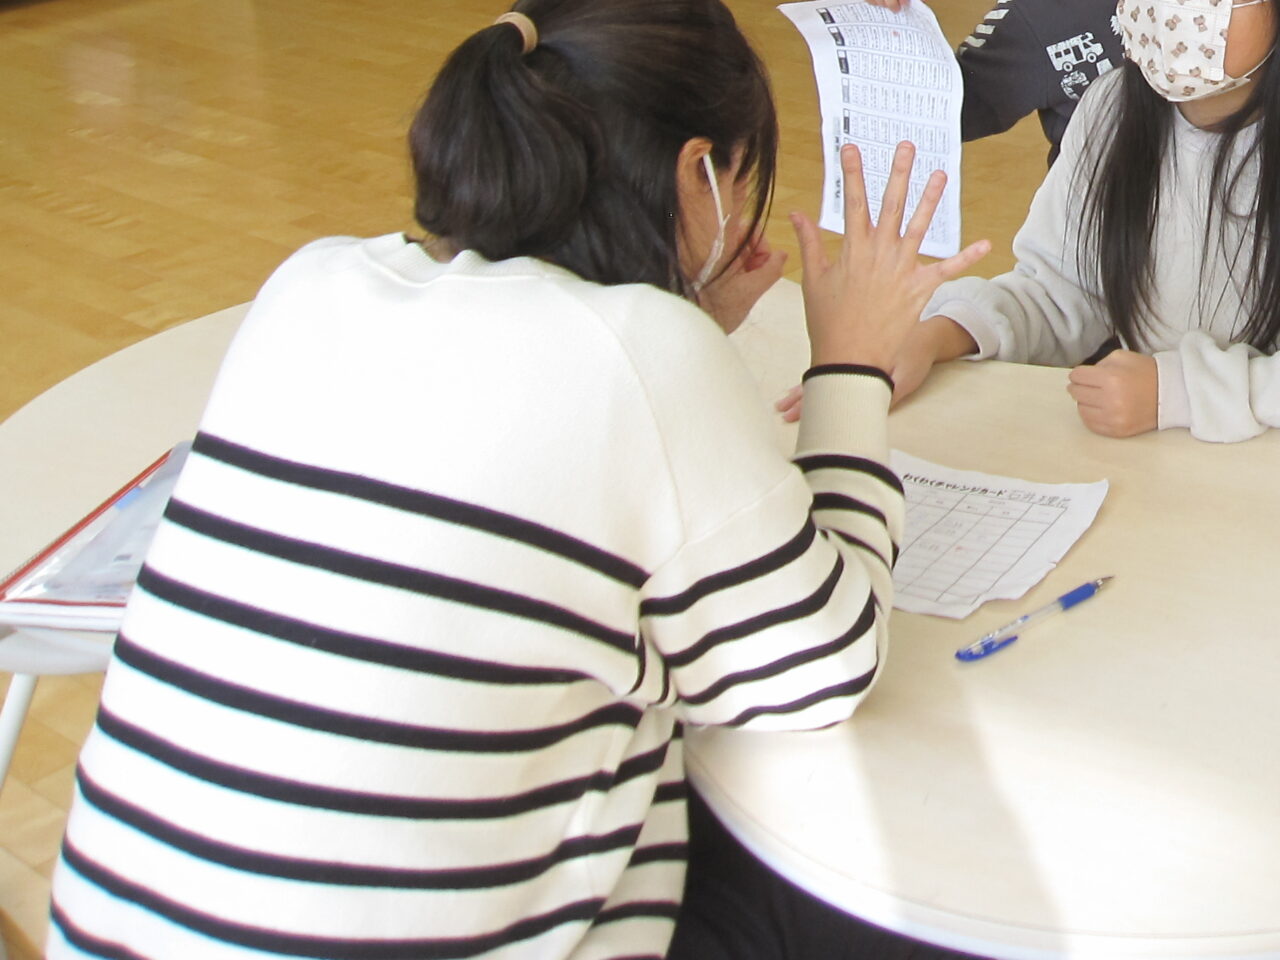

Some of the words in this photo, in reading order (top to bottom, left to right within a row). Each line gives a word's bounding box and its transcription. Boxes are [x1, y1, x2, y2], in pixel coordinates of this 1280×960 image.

[902, 472, 1008, 497] わくわくチャレンジカード
